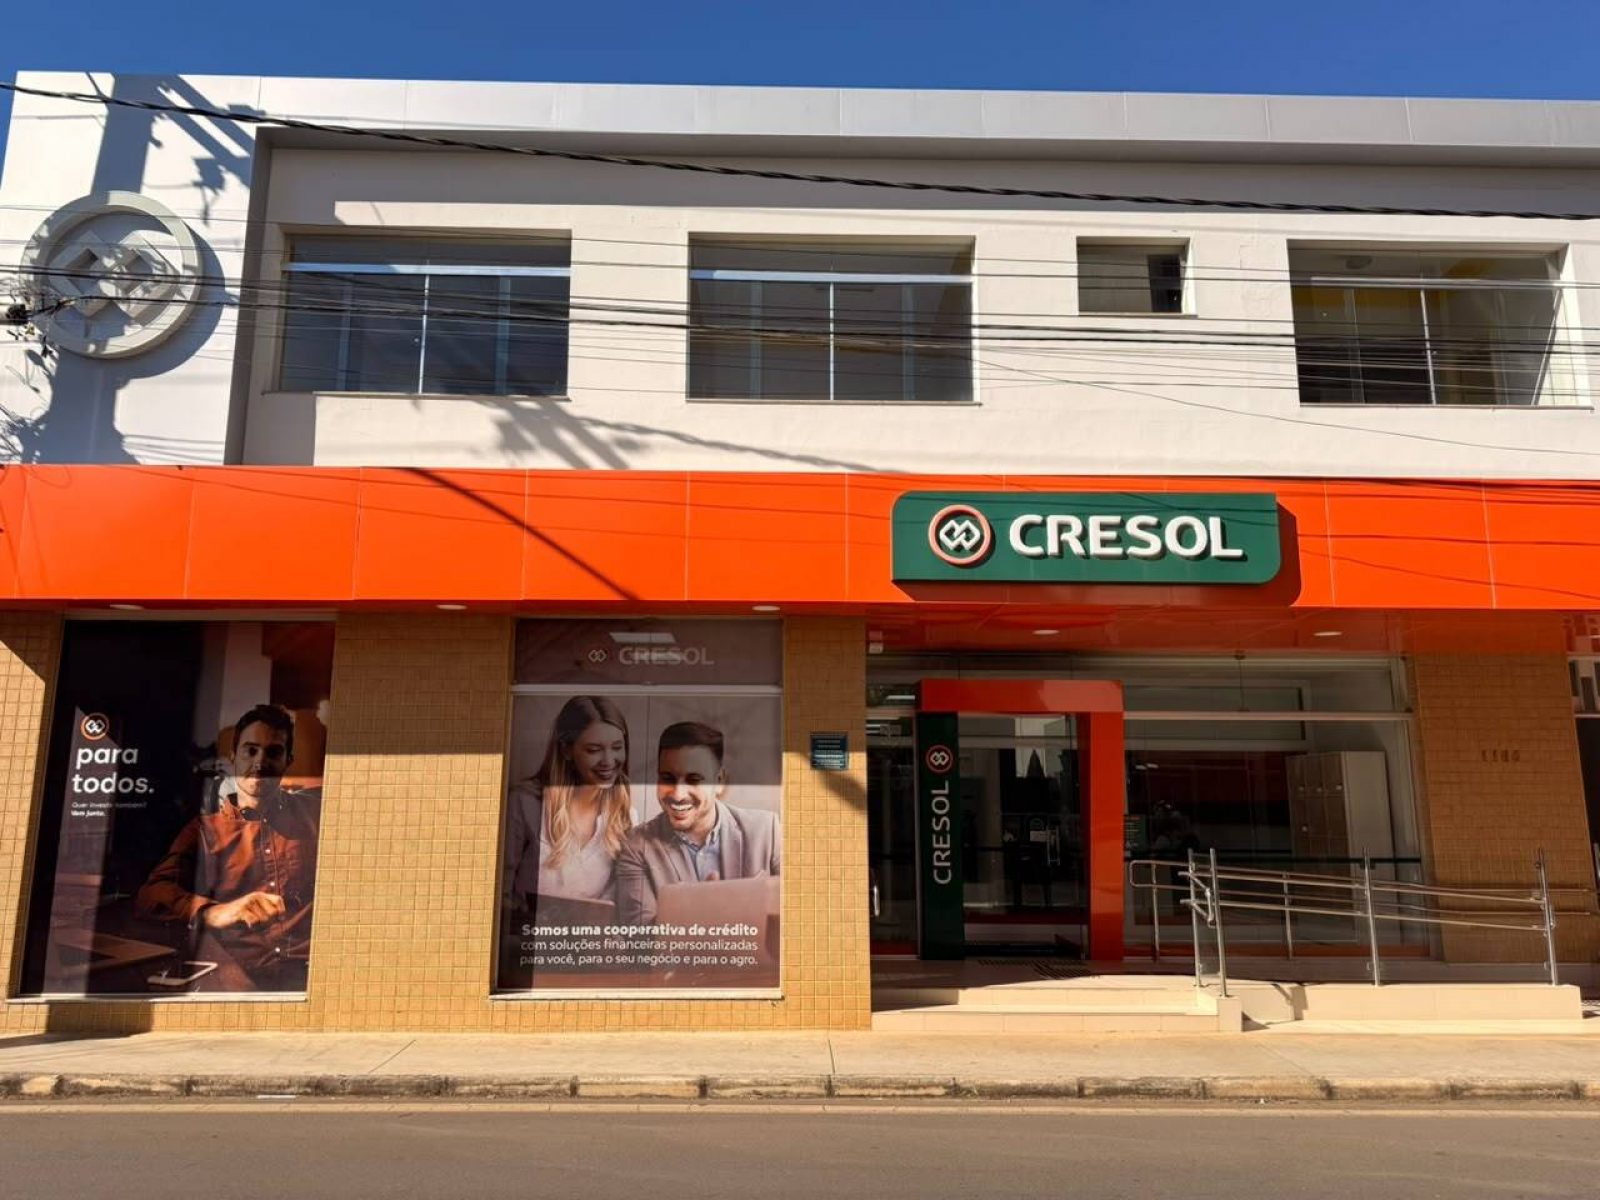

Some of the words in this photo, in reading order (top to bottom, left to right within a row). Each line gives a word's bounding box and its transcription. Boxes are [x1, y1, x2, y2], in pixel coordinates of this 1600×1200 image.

[1009, 514, 1245, 559] CRESOL
[619, 646, 715, 665] CRESOL
[76, 747, 139, 770] para
[72, 771, 155, 794] todos.
[931, 779, 952, 885] CRESOL
[521, 924, 569, 936] Somos
[571, 925, 601, 936] uma
[603, 923, 686, 938] cooperativa
[688, 923, 706, 936] de
[708, 923, 758, 936] crédito
[520, 940, 547, 951] com
[549, 938, 601, 953] soluções
[604, 938, 667, 951] financeiras
[669, 939, 759, 952] personalizadas
[520, 955, 545, 966] para
[547, 953, 576, 966] você,
[578, 955, 603, 966] para
[605, 955, 613, 964] o
[615, 955, 635, 964] seu
[637, 953, 681, 967] negócio
[683, 955, 691, 964] e
[693, 955, 717, 967] para
[720, 955, 728, 965] o
[730, 955, 758, 967] agro.
